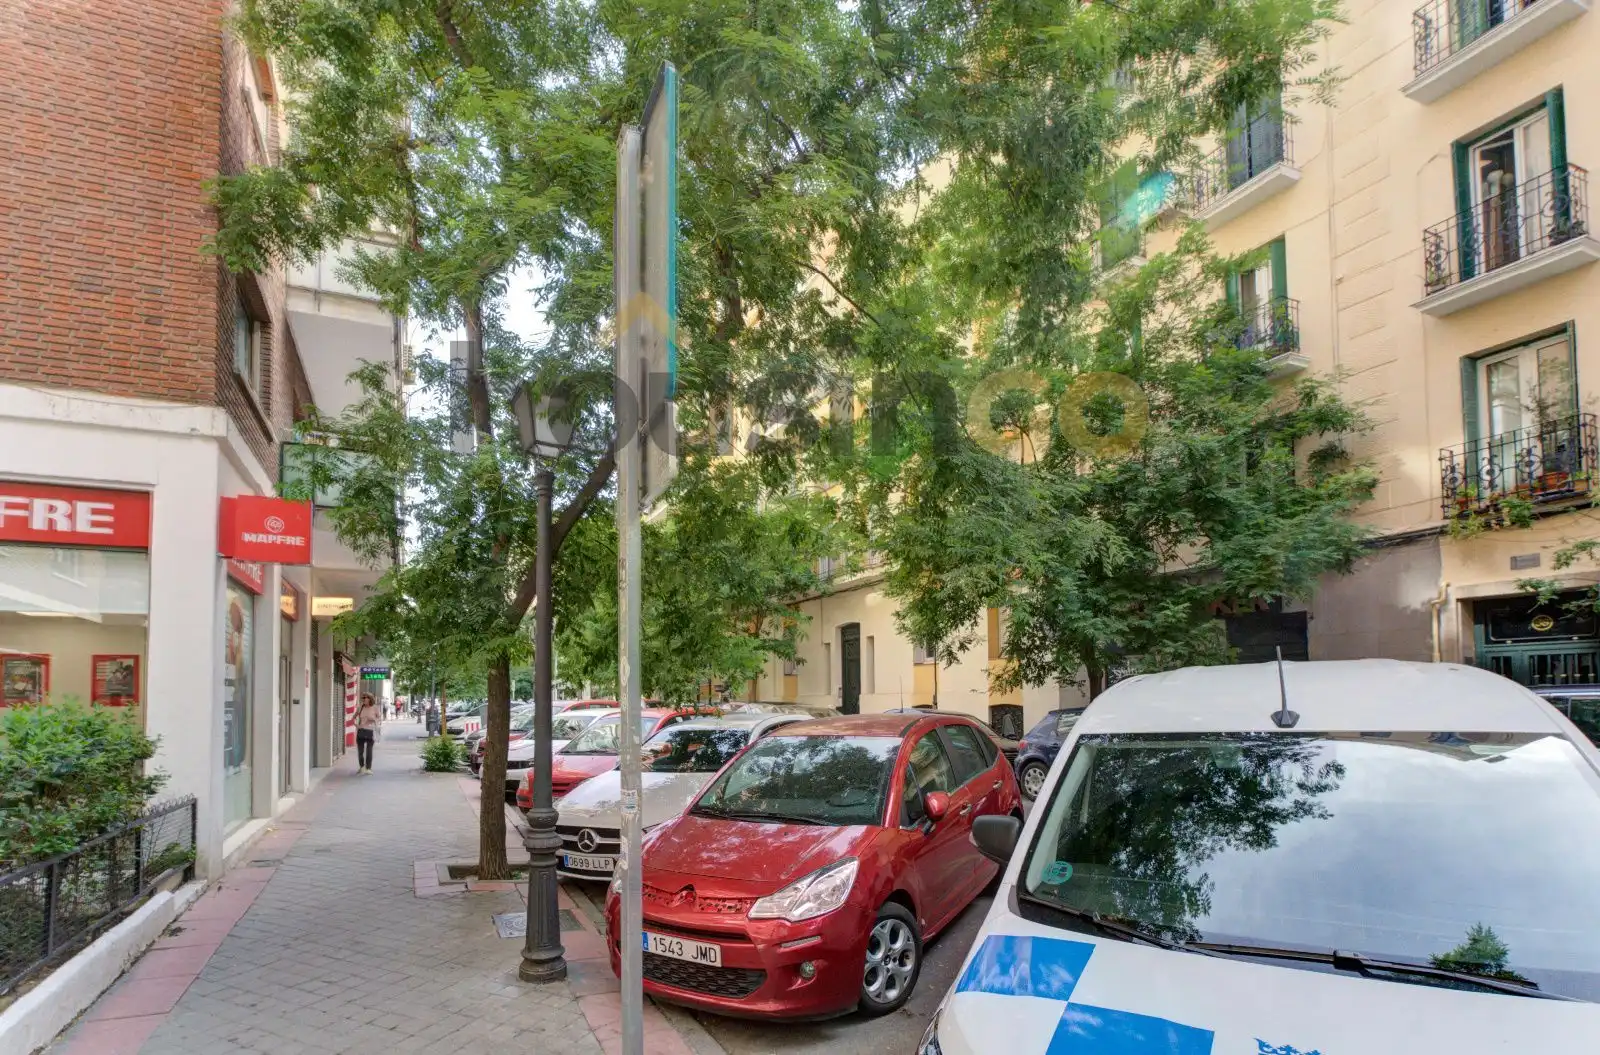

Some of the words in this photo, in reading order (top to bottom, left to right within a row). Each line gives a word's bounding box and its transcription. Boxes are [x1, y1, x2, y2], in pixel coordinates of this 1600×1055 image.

[242, 531, 305, 546] MAPFRE
[592, 859, 610, 869] LLP
[653, 936, 684, 957] 1543
[691, 944, 717, 963] JMD
